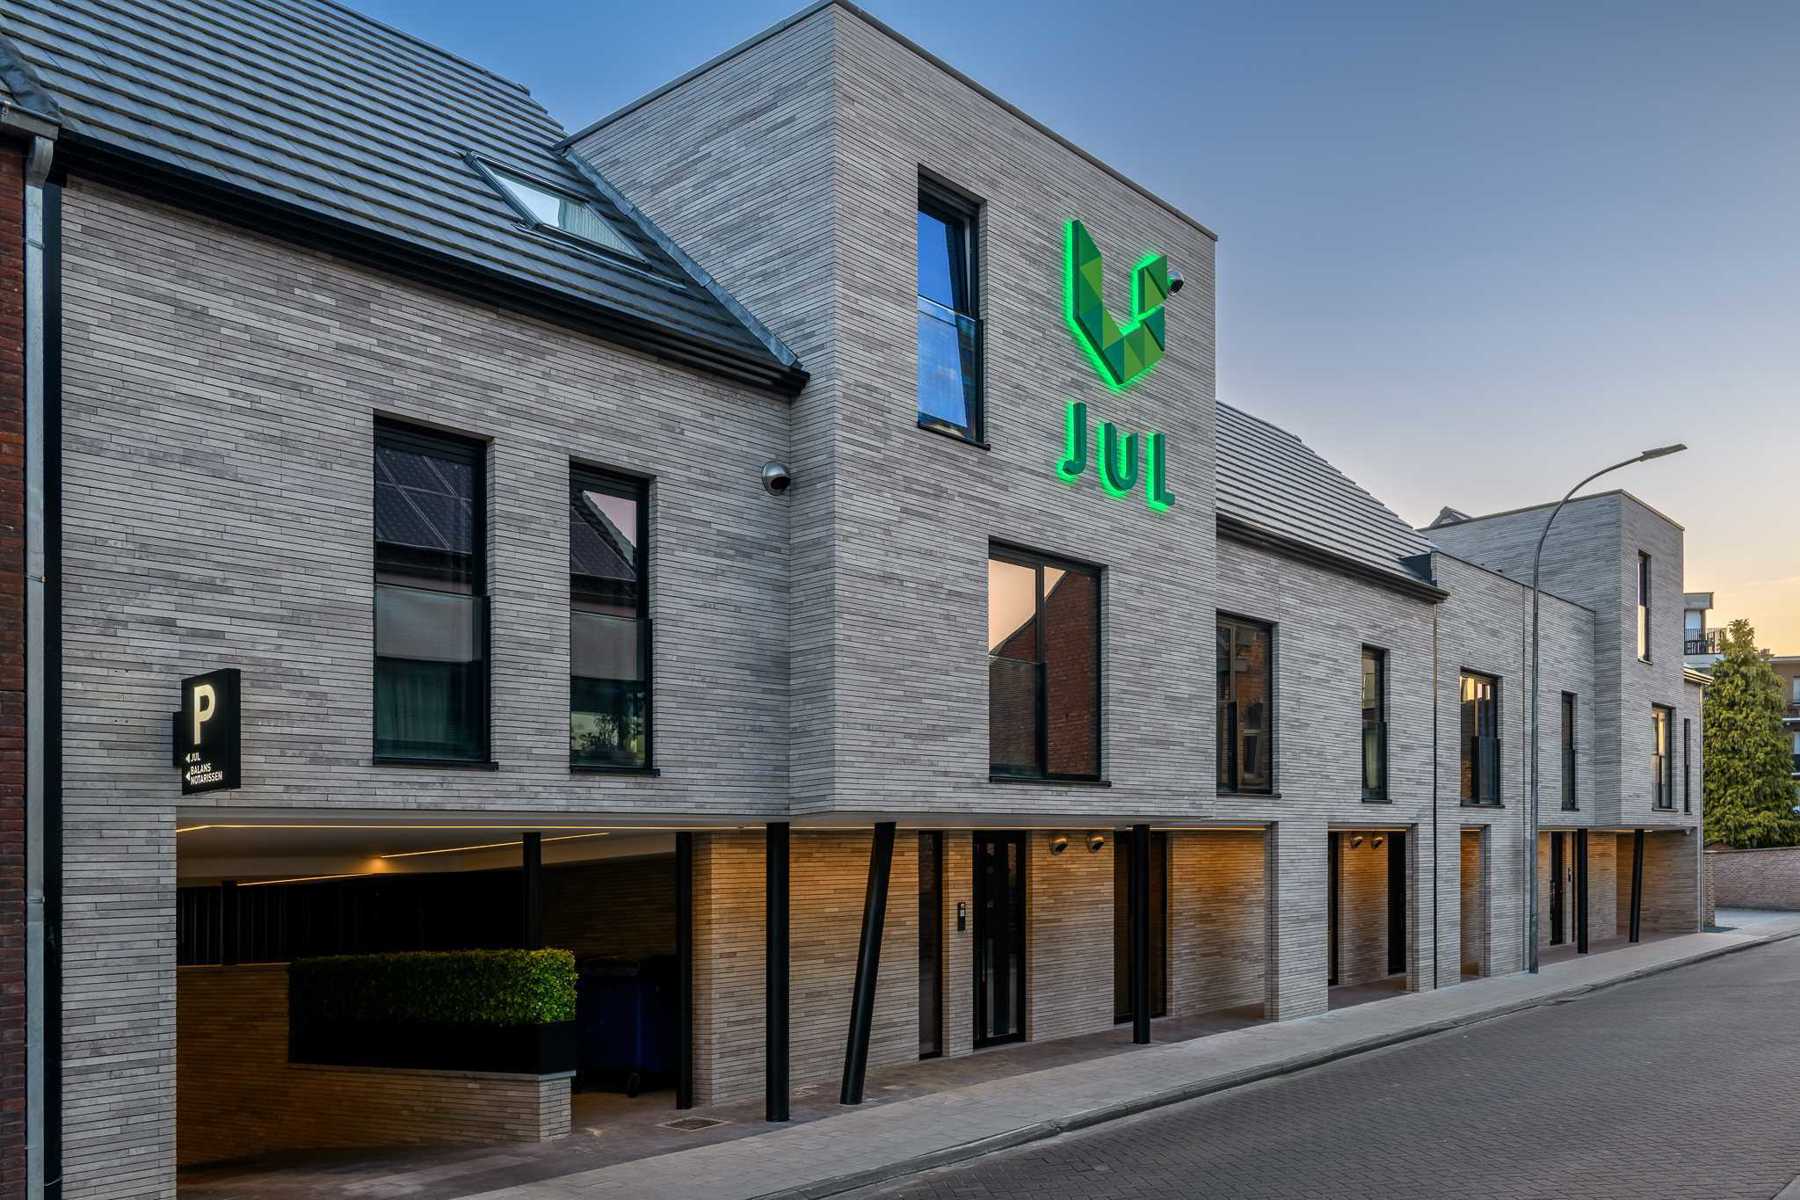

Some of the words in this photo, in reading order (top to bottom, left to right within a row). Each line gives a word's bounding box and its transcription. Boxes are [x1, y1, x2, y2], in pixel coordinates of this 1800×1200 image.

[1058, 401, 1176, 509] JUL
[193, 684, 216, 745] P
[190, 752, 201, 762] JUL
[190, 763, 212, 776] BALANS
[190, 771, 223, 785] NOTARISSEN
